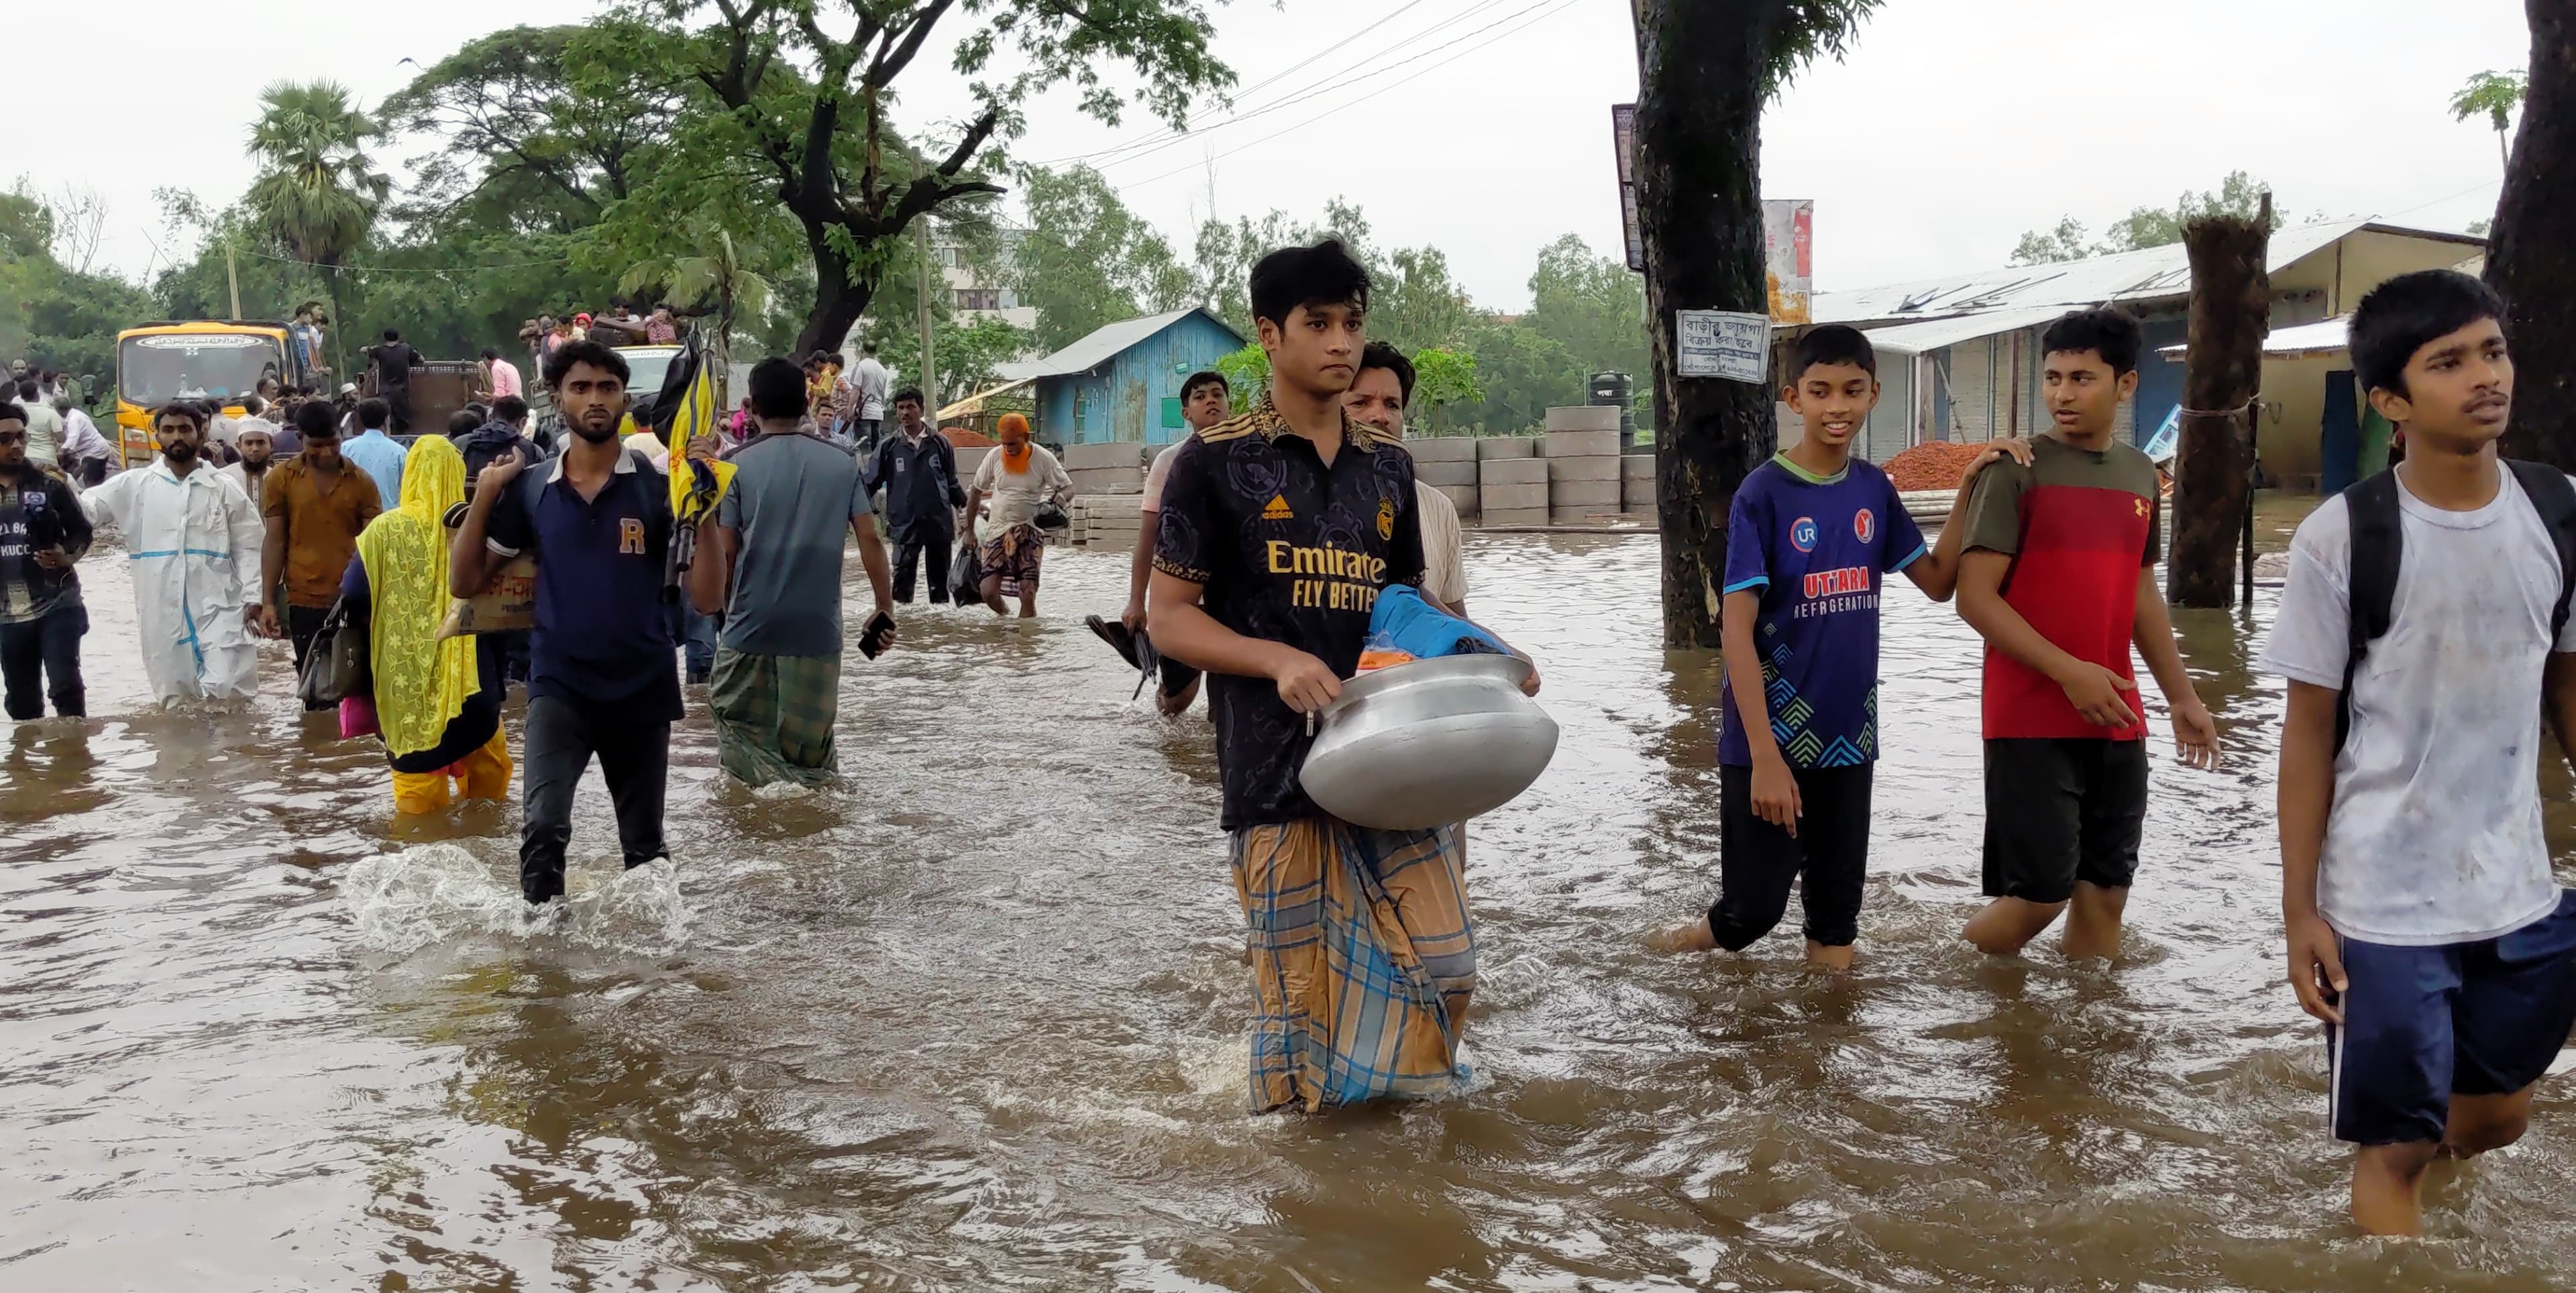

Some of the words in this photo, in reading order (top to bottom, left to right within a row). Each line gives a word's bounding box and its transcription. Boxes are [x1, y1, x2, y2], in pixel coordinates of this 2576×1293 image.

[1724, 321, 1762, 336] জায়গা
[1261, 510, 1294, 520] adidas
[619, 518, 646, 555] R
[1797, 527, 1815, 543] UR
[0, 544, 32, 557] KUCC
[1266, 539, 1387, 584] Emirate
[1292, 579, 1325, 608] FLY
